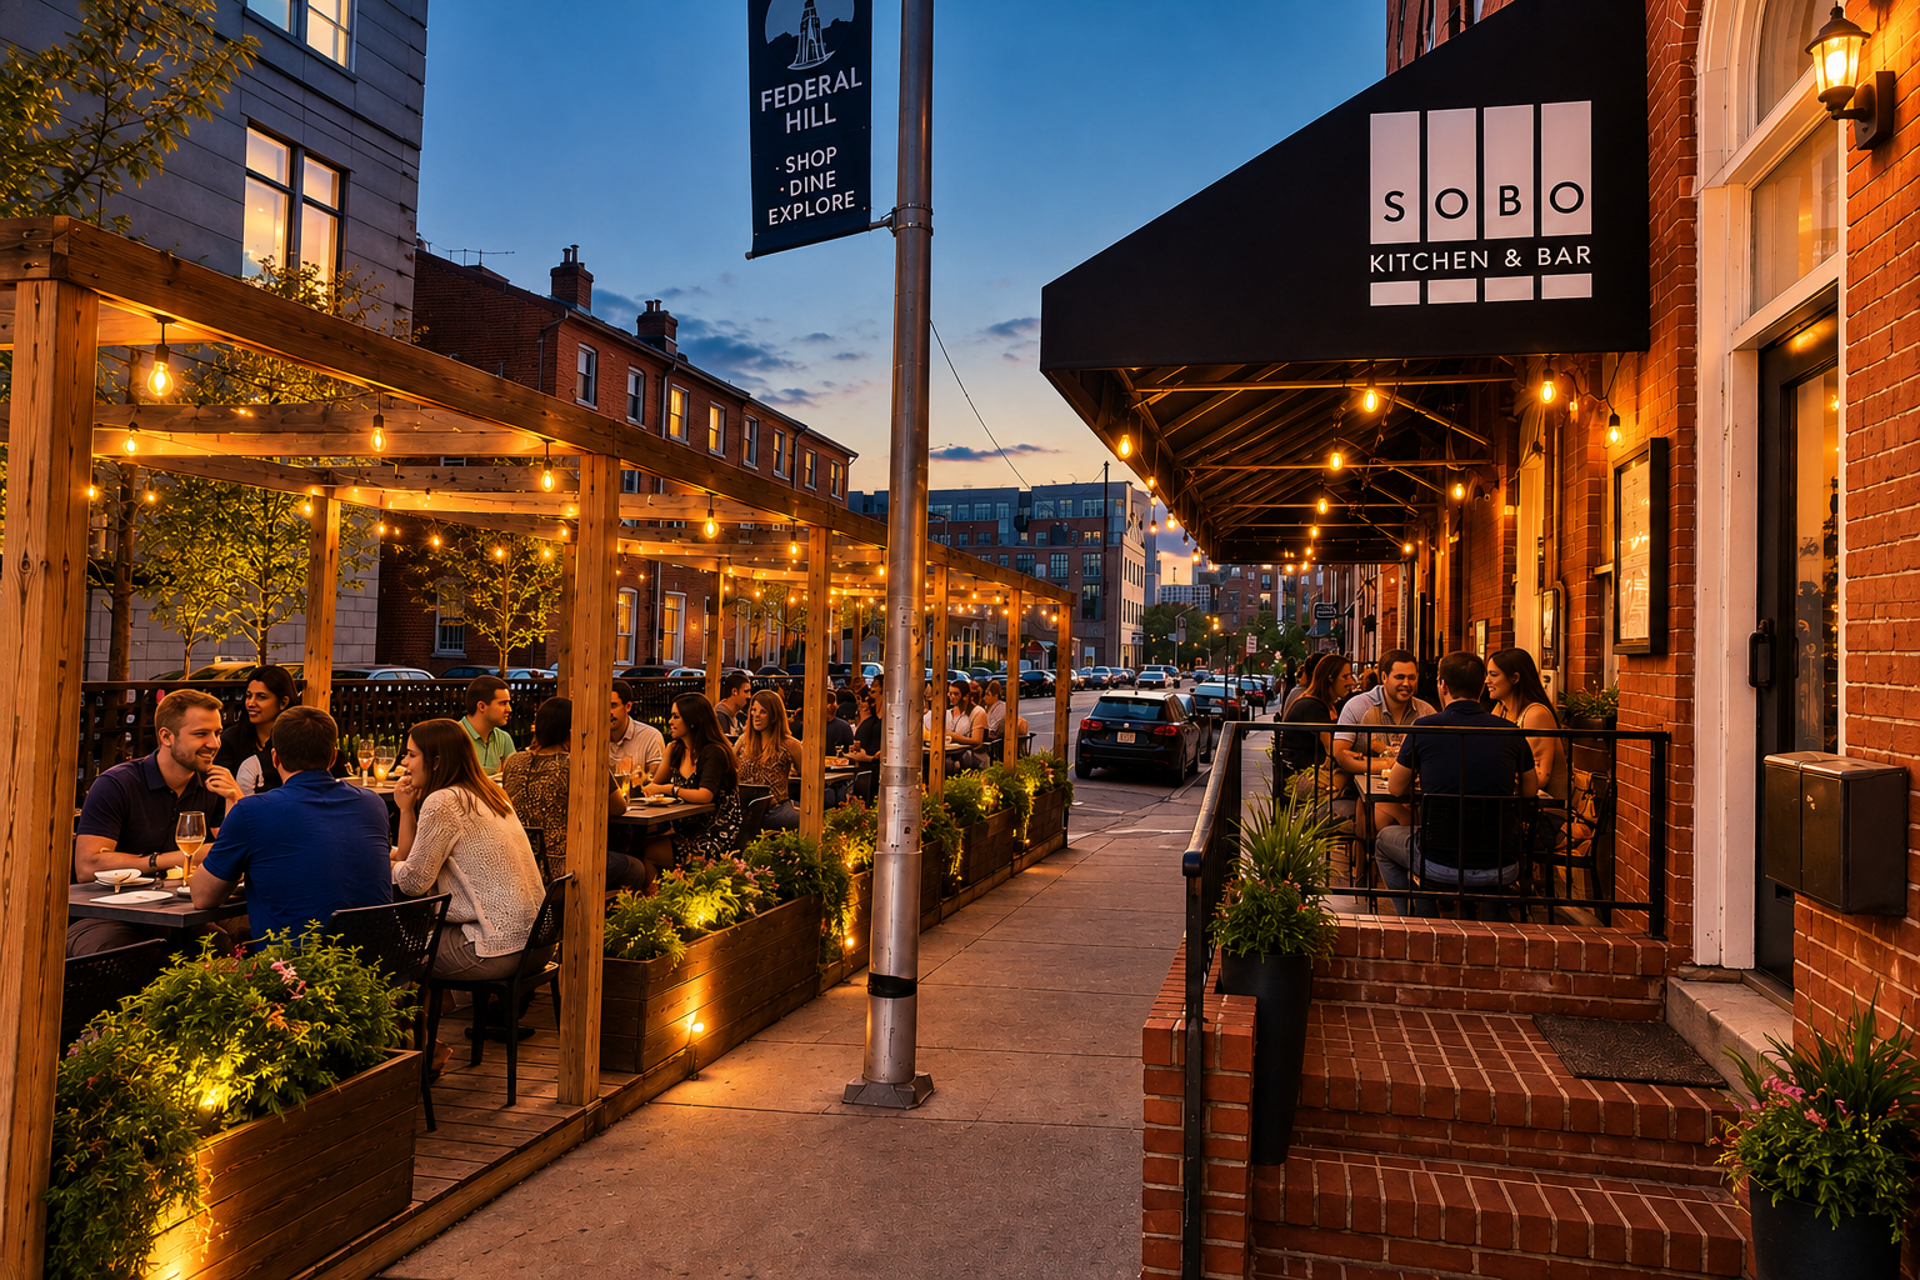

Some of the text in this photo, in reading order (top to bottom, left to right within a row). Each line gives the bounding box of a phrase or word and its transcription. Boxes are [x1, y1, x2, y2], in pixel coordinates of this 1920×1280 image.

[761, 67, 862, 112] FEDERAL
[786, 102, 837, 134] HILL
[785, 146, 837, 174] SHOP
[790, 170, 836, 197] DINE
[768, 190, 855, 226] EXPLORE
[1383, 181, 1585, 223] SOBO
[1370, 245, 1591, 273] KITCHEN & BAR
